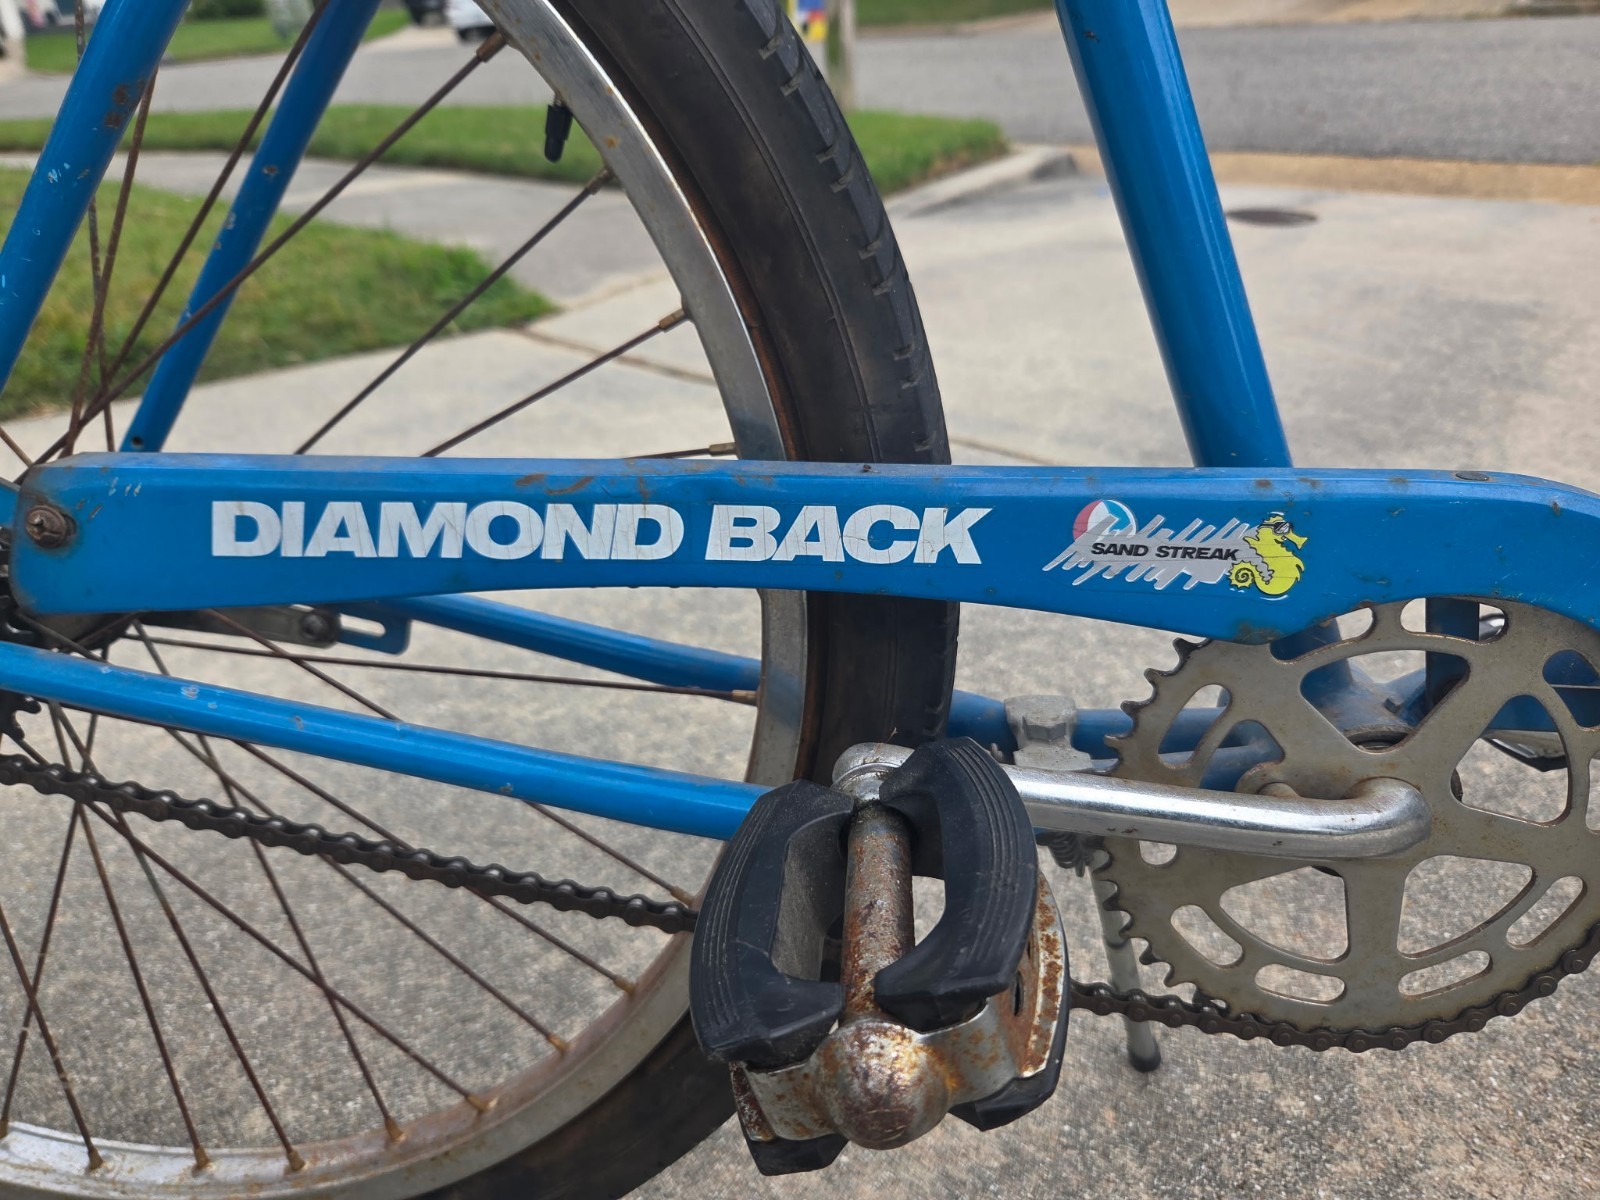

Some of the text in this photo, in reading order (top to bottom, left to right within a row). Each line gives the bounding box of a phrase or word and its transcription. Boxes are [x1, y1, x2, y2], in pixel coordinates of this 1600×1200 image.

[211, 501, 993, 564] DIAMOND BACK
[1091, 542, 1239, 561] SAND STREAK
